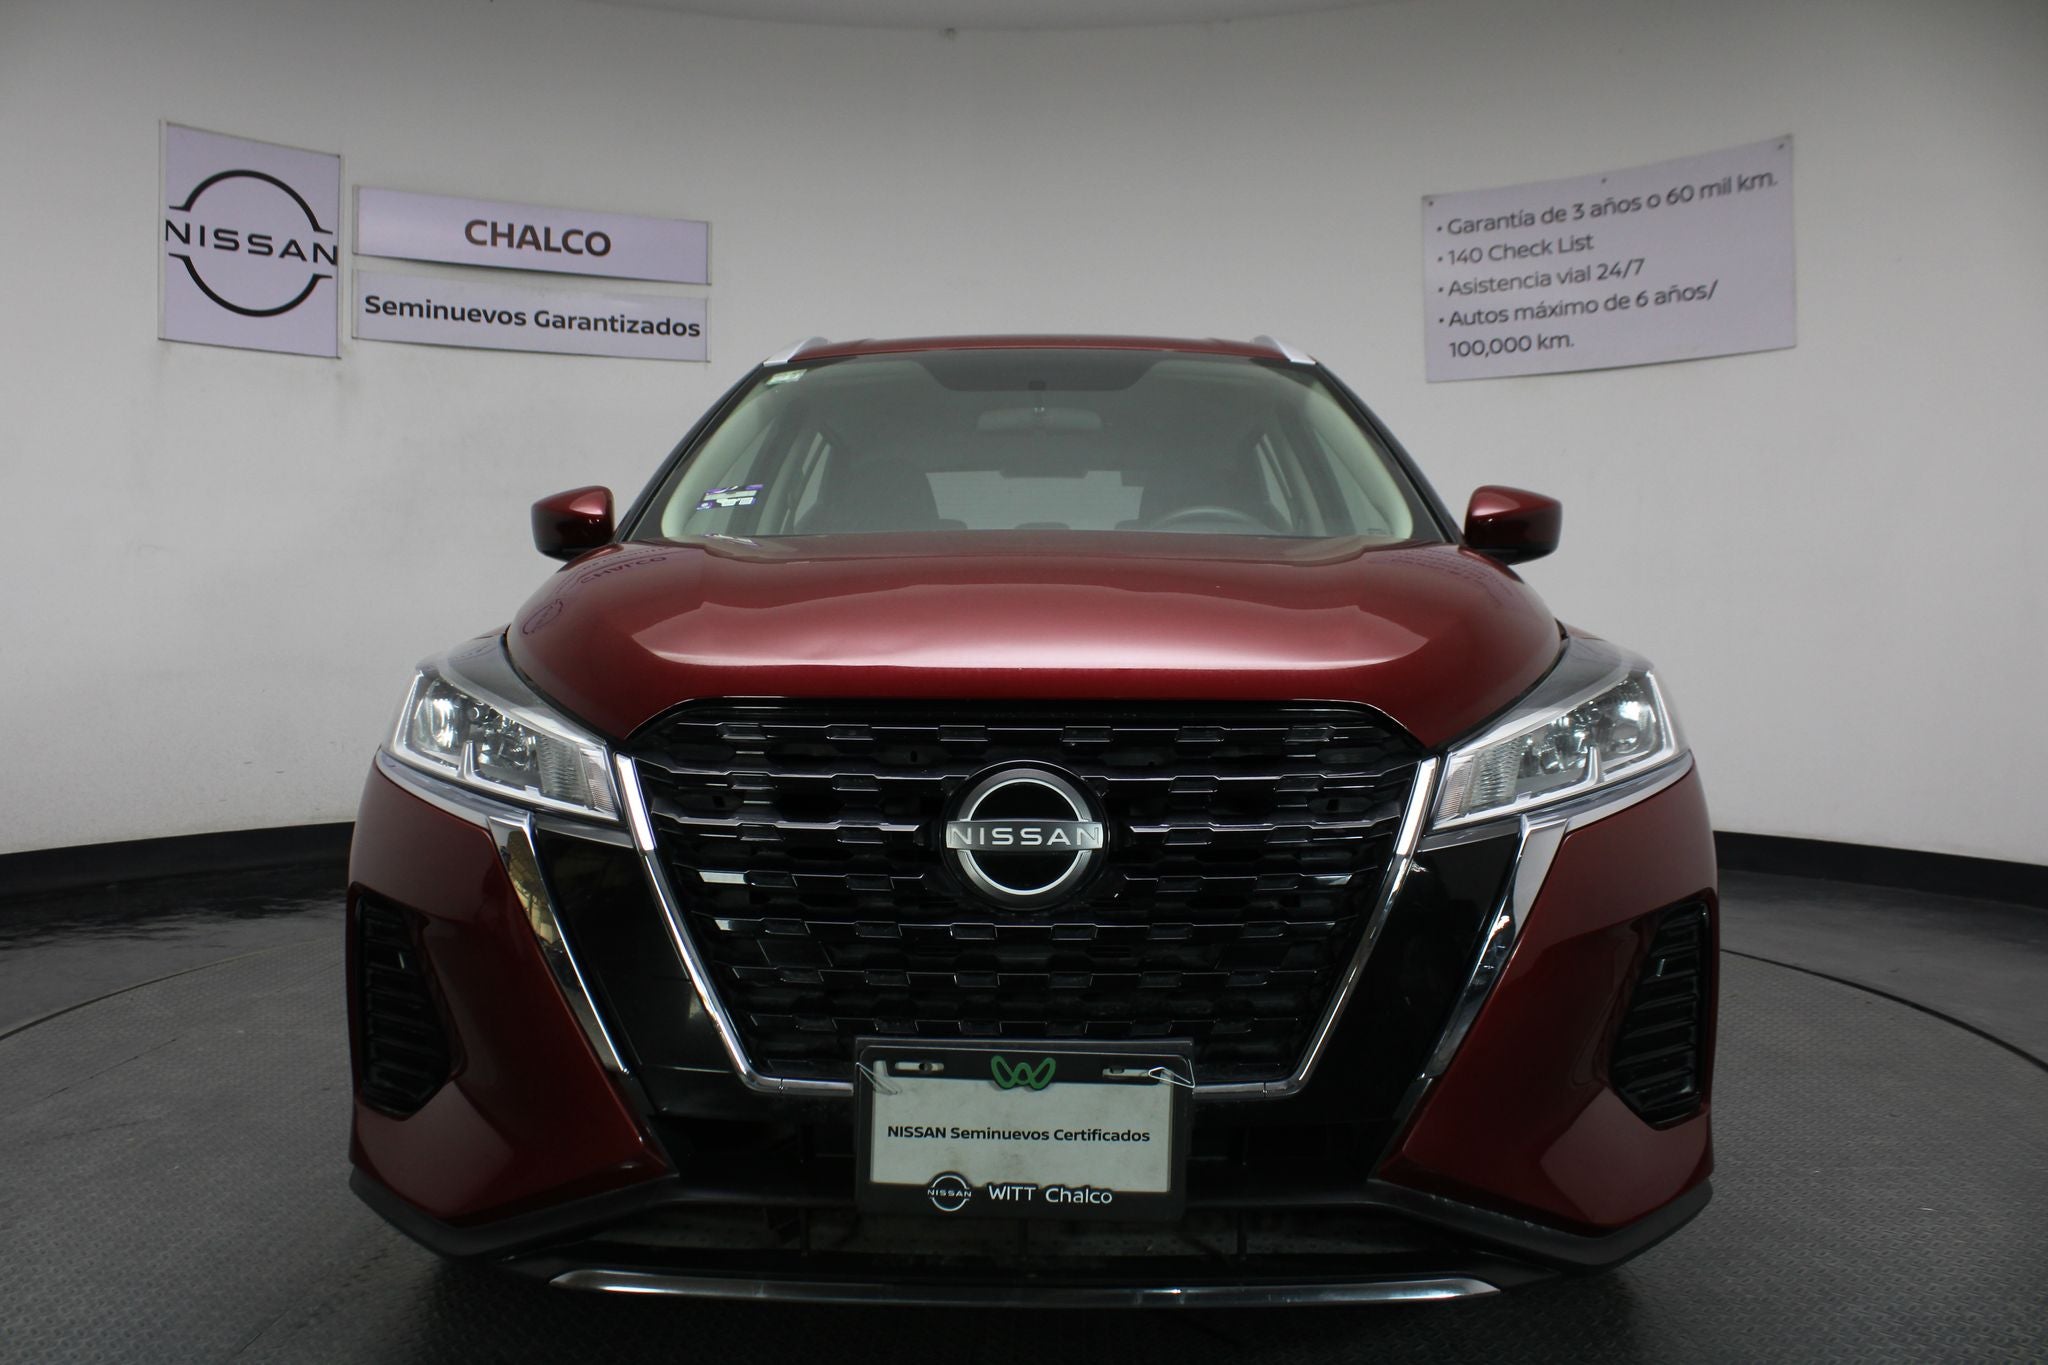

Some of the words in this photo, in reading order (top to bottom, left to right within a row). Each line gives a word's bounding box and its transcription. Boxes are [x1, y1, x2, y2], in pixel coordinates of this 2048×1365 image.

[1447, 210, 1535, 235] Garantía
[1541, 203, 1567, 223] de
[1573, 203, 1585, 221] 3
[1590, 197, 1642, 218] años
[1647, 194, 1661, 209] o
[1666, 185, 1694, 204] 60
[1700, 176, 1732, 200] mil
[1737, 169, 1779, 193] km.
[165, 219, 338, 266] NISSAN
[464, 219, 611, 257] CHALCO
[1448, 248, 1483, 265] 140
[1488, 238, 1552, 262] Check
[1558, 233, 1595, 253] List
[1448, 272, 1552, 296] Asistencia
[1556, 264, 1591, 285] vial
[1596, 258, 1646, 281] 24/7
[365, 295, 527, 326] Seminuevos
[534, 310, 701, 338] Garantizados
[1448, 307, 1509, 327] Autos
[1514, 297, 1599, 320] máximo
[1604, 291, 1631, 311] de
[1636, 289, 1648, 307] 6
[1654, 280, 1719, 303] años/
[1449, 334, 1532, 359] 100,000
[1537, 328, 1575, 350] km.
[950, 827, 1100, 846] NISSAN
[888, 1126, 946, 1139] NISSAN
[950, 1126, 1049, 1141] Seminuevos
[1053, 1128, 1150, 1142] Certificados
[927, 1188, 972, 1198] NISSAN
[988, 1184, 1037, 1202] WITT
[1045, 1187, 1113, 1204] Chalco
